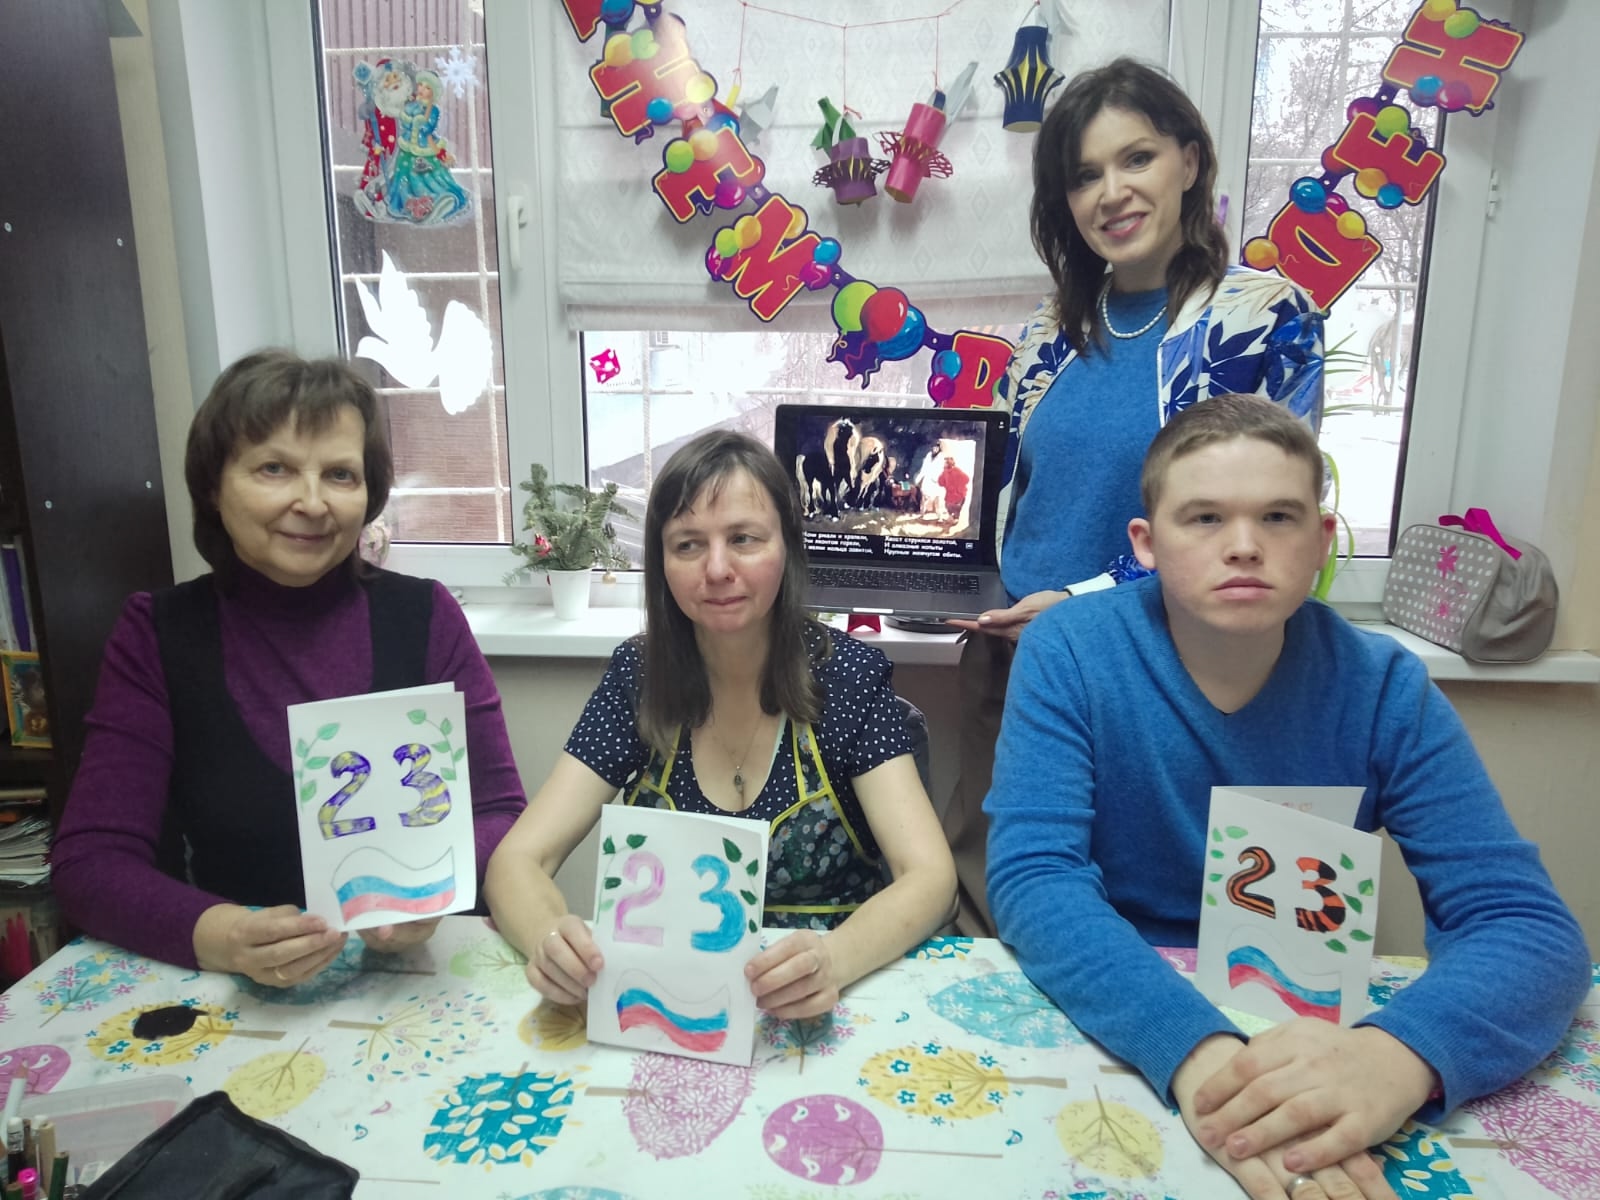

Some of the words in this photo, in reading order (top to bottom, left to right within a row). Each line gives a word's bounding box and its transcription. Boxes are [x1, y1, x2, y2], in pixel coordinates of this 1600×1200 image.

[318, 743, 451, 840] 23
[613, 851, 746, 953] 23
[1226, 846, 1346, 933] 23
